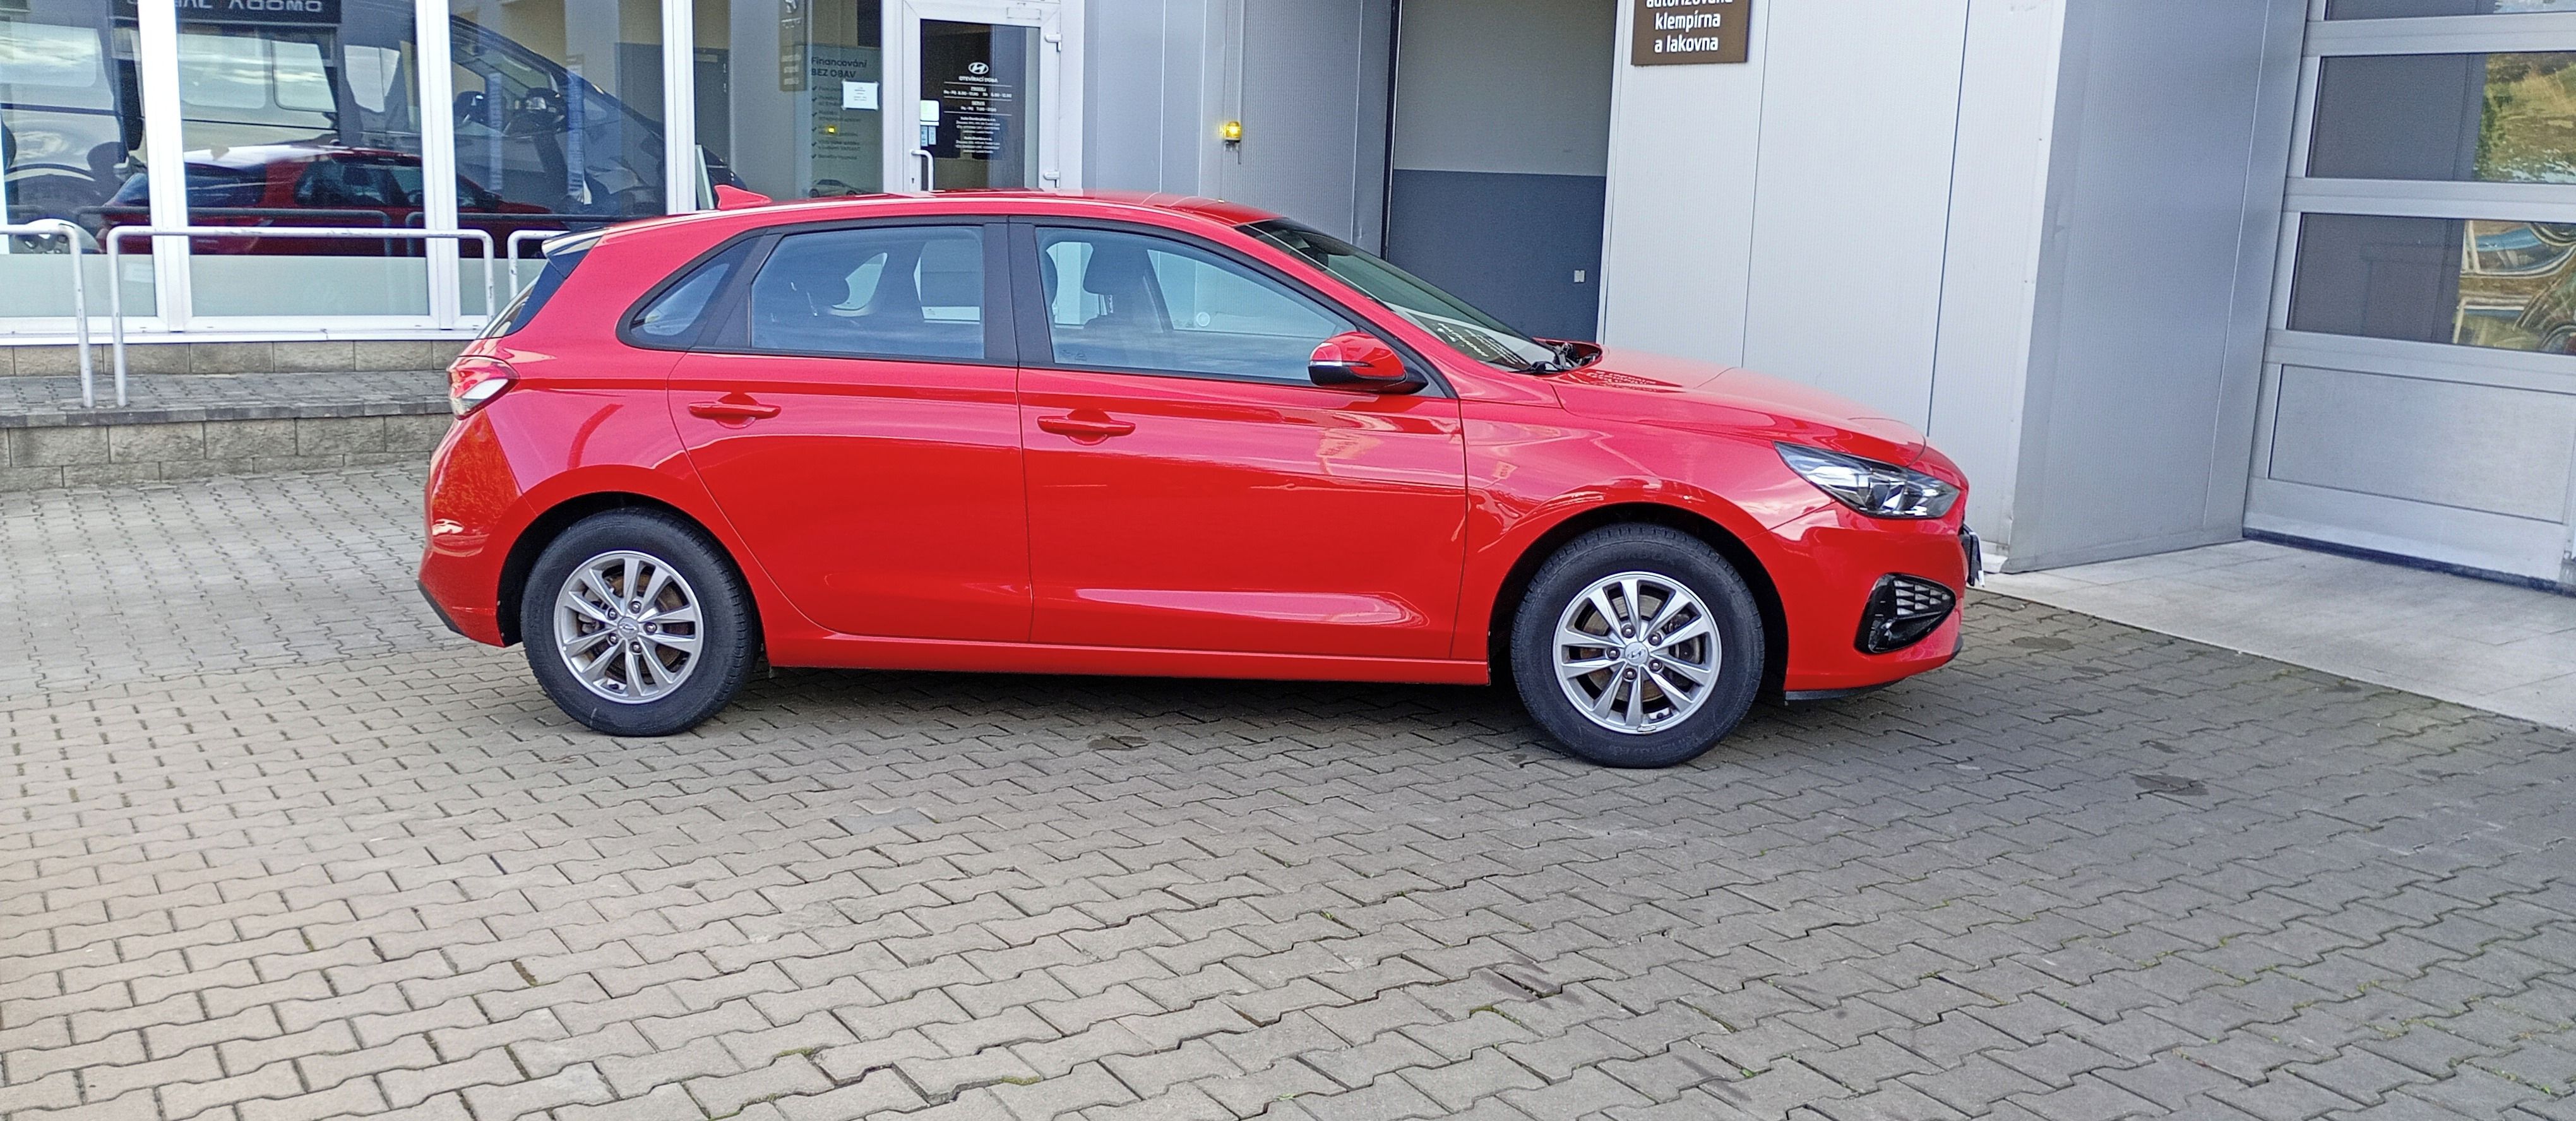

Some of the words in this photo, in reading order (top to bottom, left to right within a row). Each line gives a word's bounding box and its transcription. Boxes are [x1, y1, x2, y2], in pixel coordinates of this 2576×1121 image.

[1655, 9, 1721, 32] klempírna
[1654, 39, 1663, 52] a
[1666, 34, 1719, 52] lakovna
[811, 68, 828, 76] BEZ
[830, 69, 856, 78] OBAV
